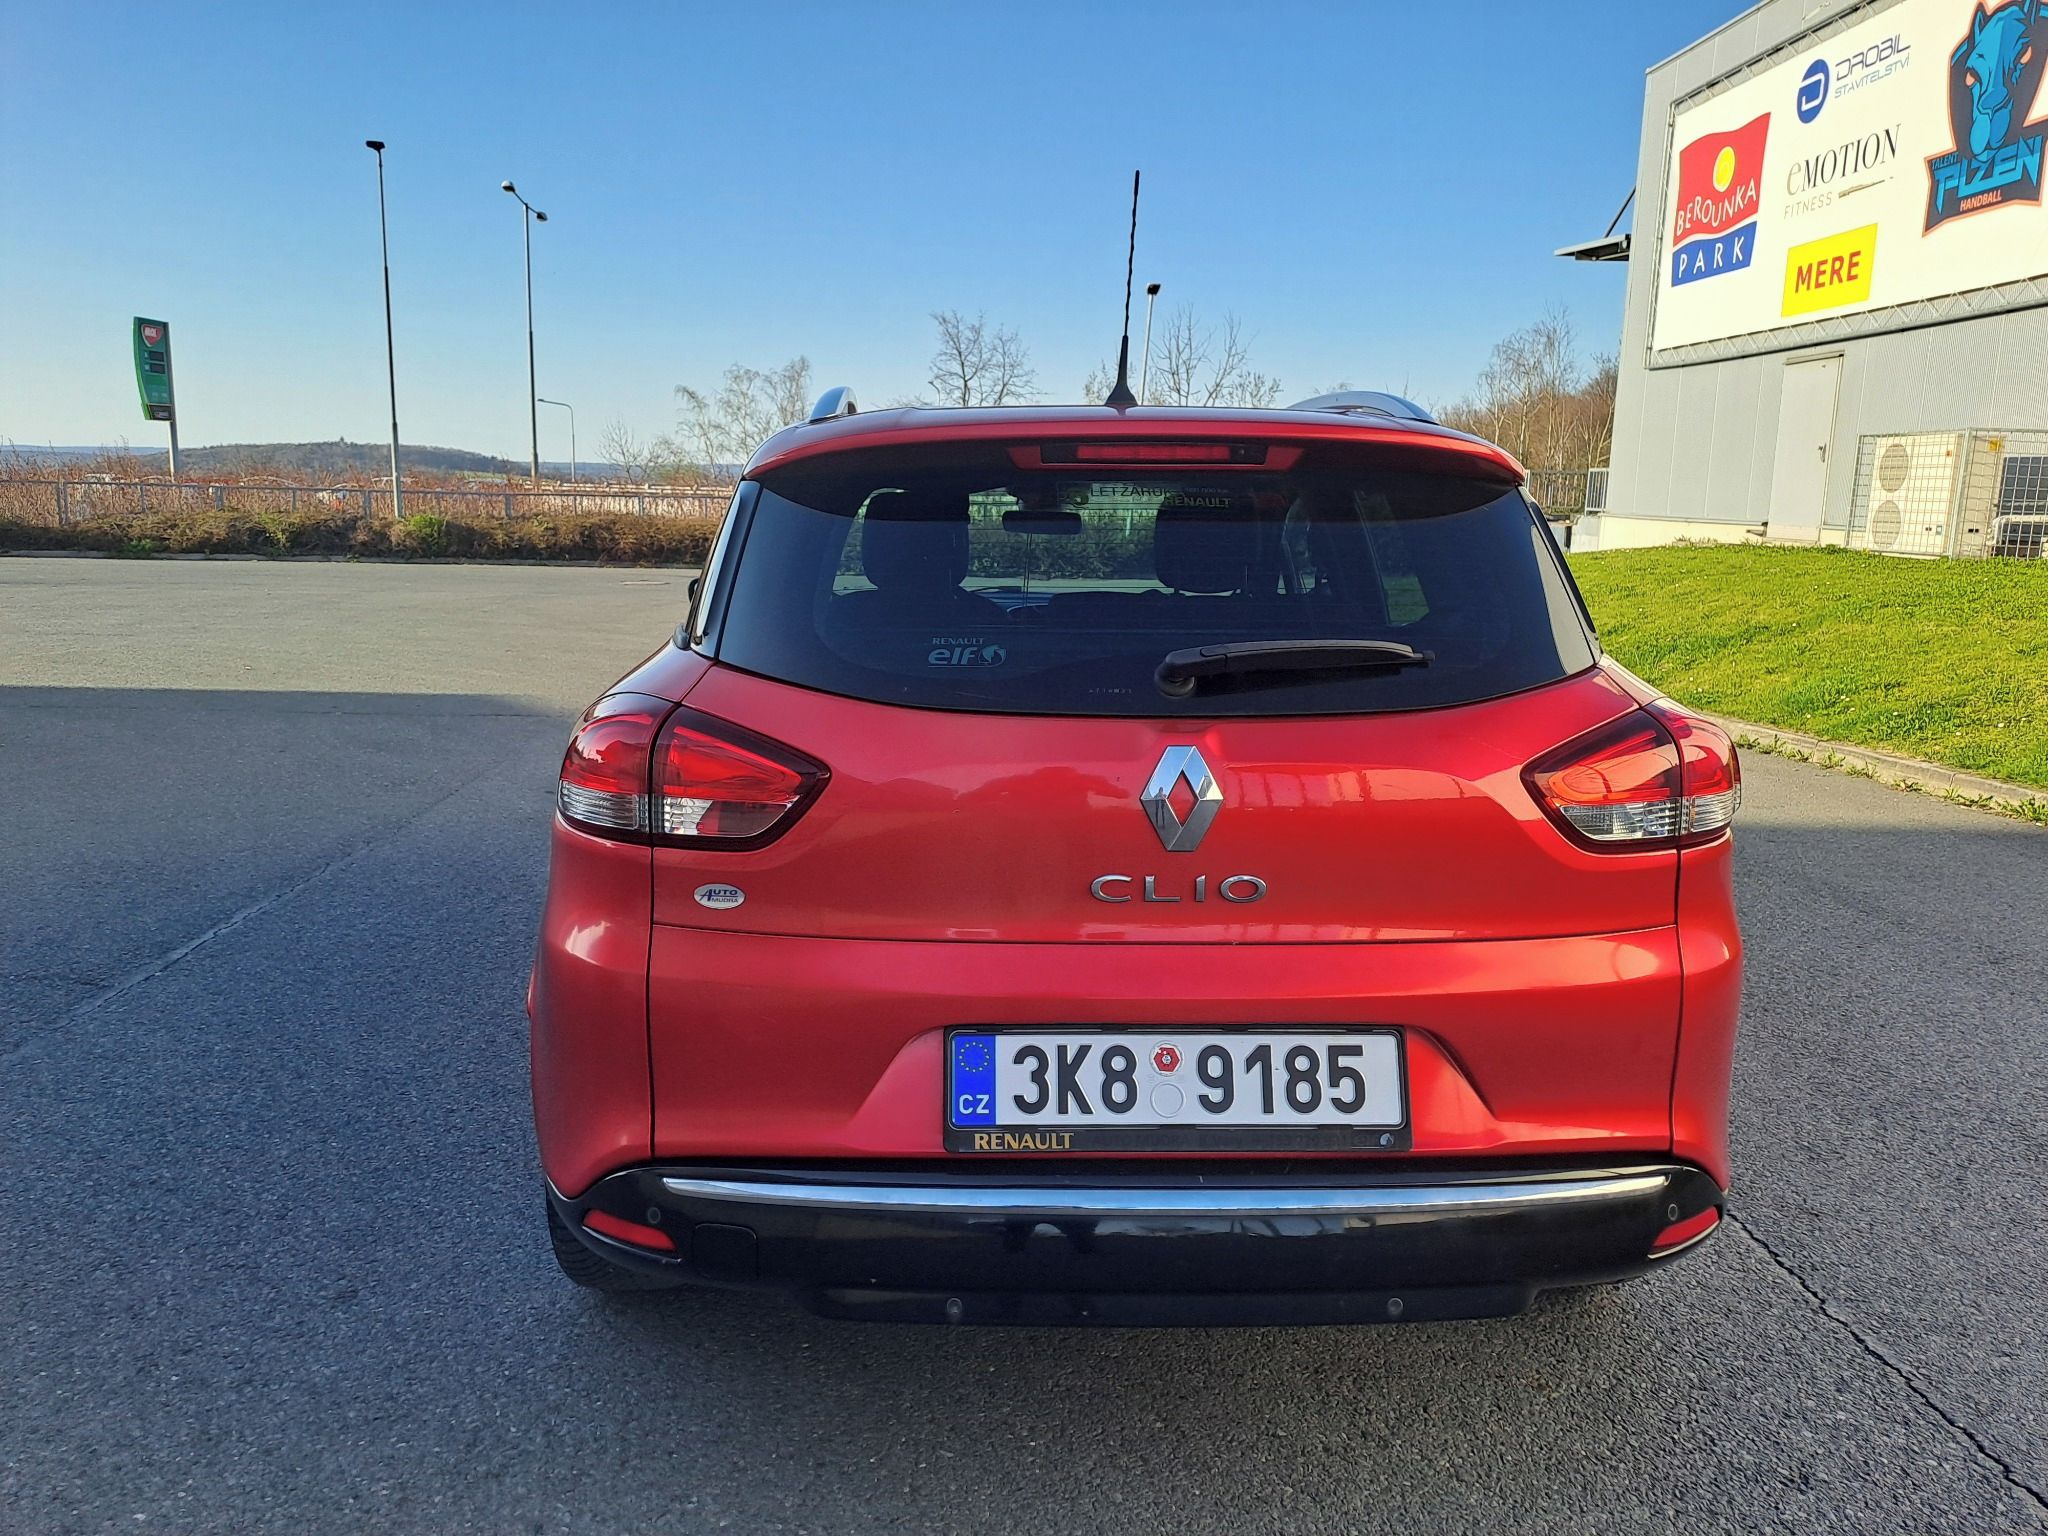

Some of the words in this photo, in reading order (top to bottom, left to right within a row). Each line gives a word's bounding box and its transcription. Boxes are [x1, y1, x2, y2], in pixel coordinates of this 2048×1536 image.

[1835, 34, 1911, 82] DROBIL
[1786, 123, 1902, 196] eMOTION
[1676, 177, 1757, 237] BEROUNKA
[1783, 191, 1833, 220] FITNESS
[1960, 189, 2002, 212] HANDBALL
[1678, 236, 1744, 278] PARK
[1795, 250, 1861, 293] MERE
[1165, 496, 1231, 508] RENAULT
[932, 637, 985, 645] RENAULT
[927, 647, 978, 665] elf
[699, 889, 738, 902] AUTO
[1090, 874, 1267, 903] CLIO
[1012, 1044, 1139, 1115] 3K8
[1197, 1044, 1366, 1115] 9185
[958, 1094, 990, 1115] CZ
[973, 1132, 1075, 1150] RENAULT
